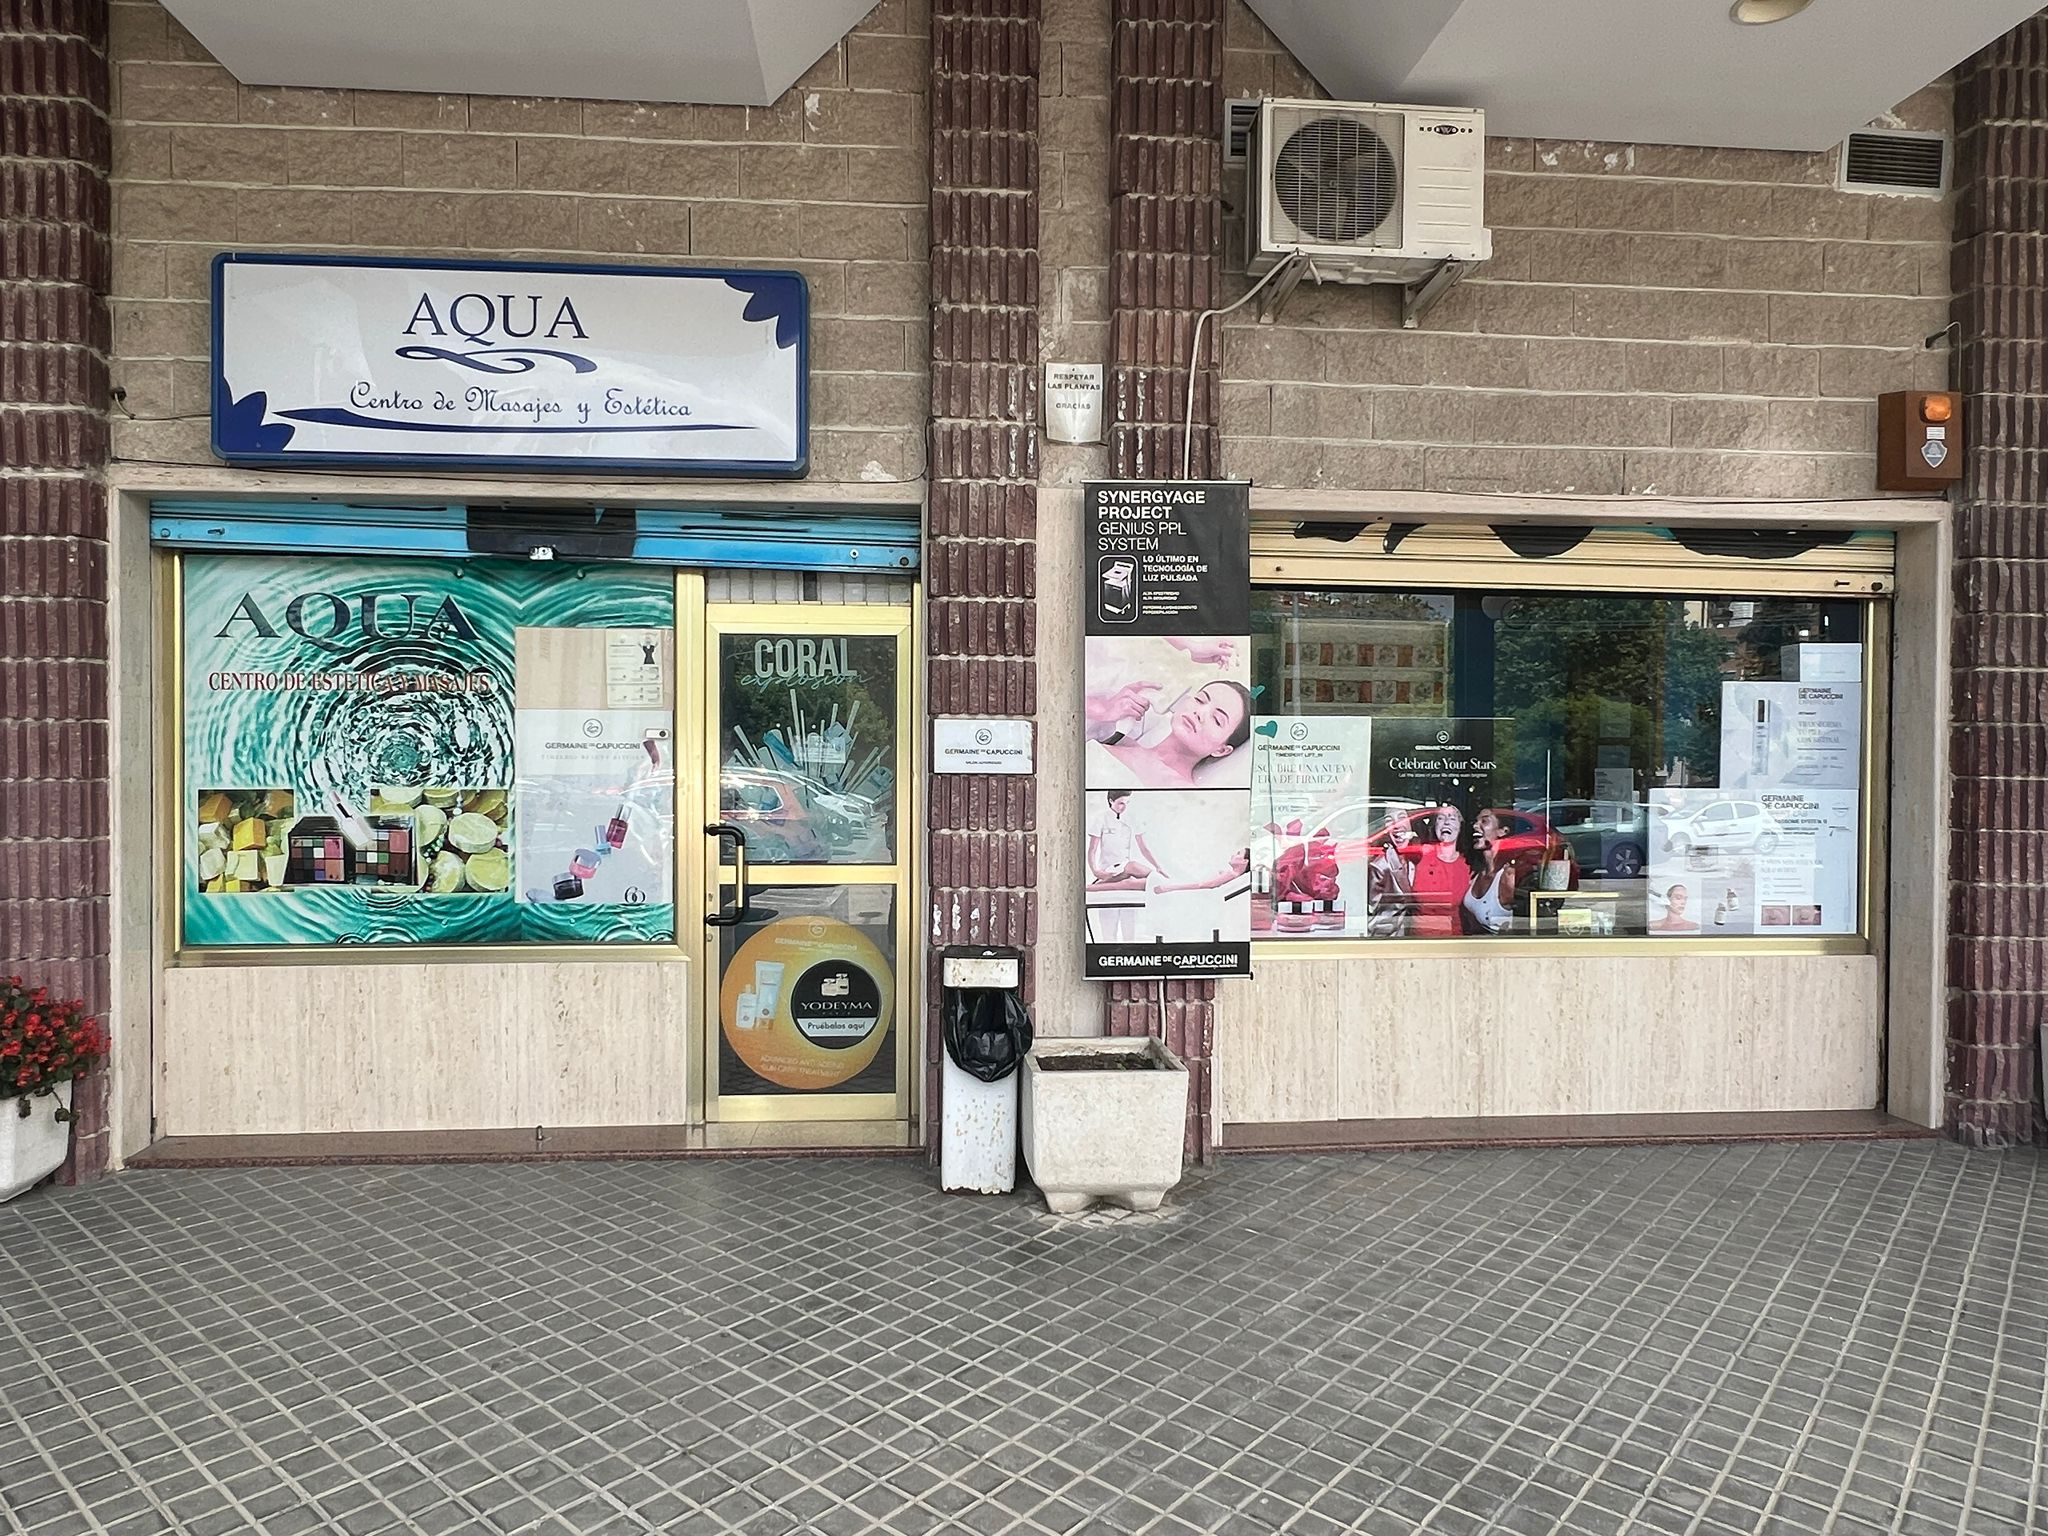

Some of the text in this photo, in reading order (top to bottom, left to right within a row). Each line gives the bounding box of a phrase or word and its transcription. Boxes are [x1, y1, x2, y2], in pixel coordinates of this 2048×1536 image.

[402, 292, 589, 346] AQUA
[349, 381, 693, 424] Centro de Masajes y Estética
[1055, 402, 1091, 410] GRACIAS
[1098, 490, 1206, 504] SYNERGYAGE
[1098, 506, 1173, 519] PROJECT
[1098, 521, 1187, 535] GENIUS PPL
[1098, 537, 1159, 551] SYSTEM
[1142, 554, 1199, 563] LO ÚLTIMO EN
[1142, 564, 1208, 573] TECNOLOGÍA DE
[1142, 574, 1198, 582] LUZ PULSADA
[214, 592, 482, 650] AQUA
[754, 637, 858, 678] CORAL
[208, 671, 278, 691] CENTRO
[284, 672, 308, 691] DE
[395, 674, 409, 692] Y
[414, 672, 491, 693] MASAJES
[1298, 764, 1319, 773] UNA
[1322, 764, 1353, 774] NUEVA
[1389, 757, 1497, 770] Celebrate Your Stars
[1258, 775, 1339, 784] ERA DE FIRMEZA
[1761, 794, 1804, 802] GERMAINE
[1098, 955, 1162, 967] GERMAINE
[1173, 954, 1238, 966] CAPUCCINI
[801, 1001, 873, 1010] YODEYMA
[847, 1021, 866, 1031] aquí
